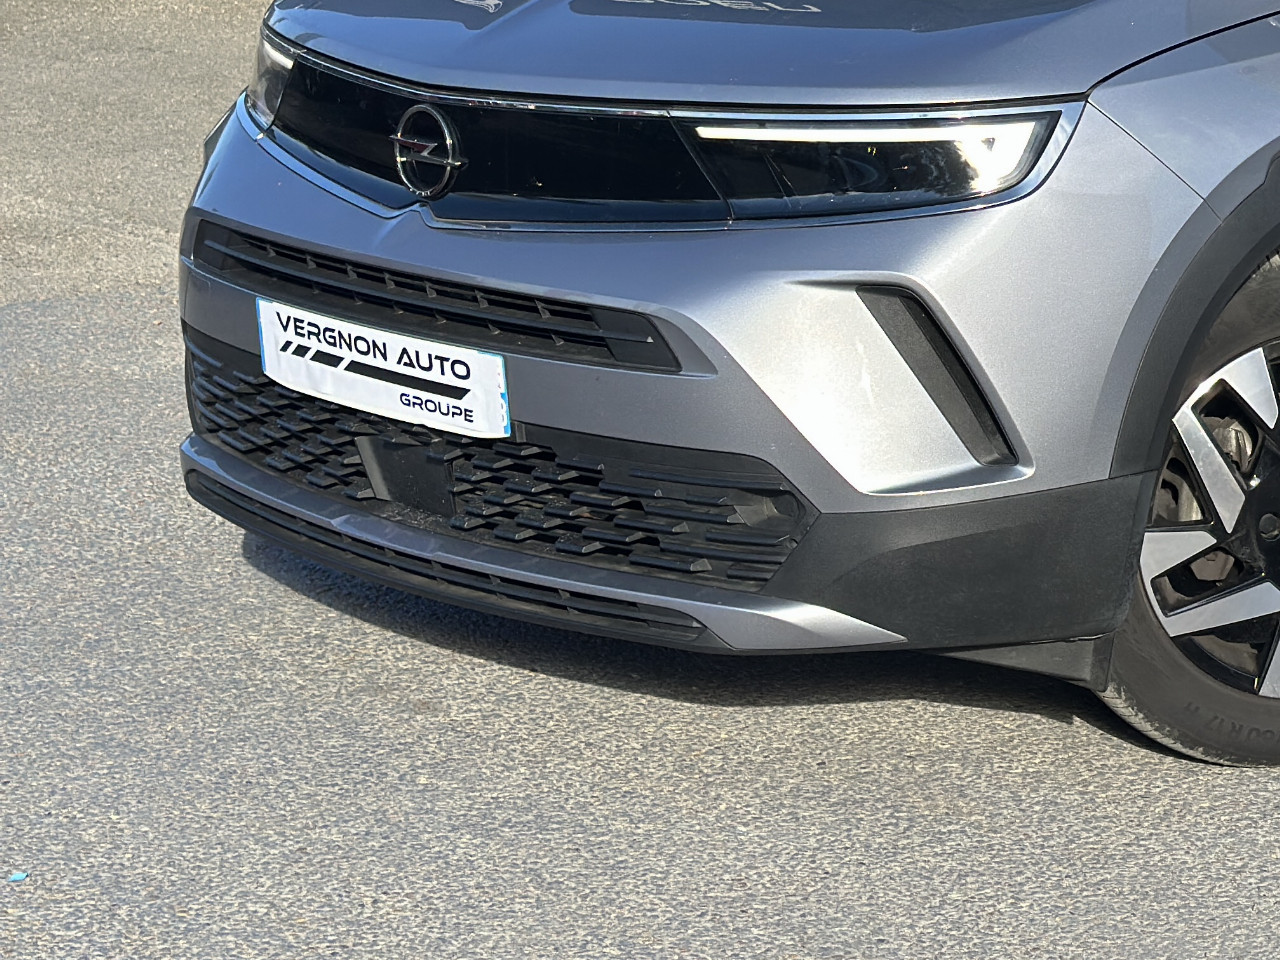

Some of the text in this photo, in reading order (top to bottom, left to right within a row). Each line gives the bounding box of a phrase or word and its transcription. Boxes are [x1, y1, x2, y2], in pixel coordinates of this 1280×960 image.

[275, 311, 471, 380] VERGNON AUTO
[400, 392, 474, 423] GROUPE
